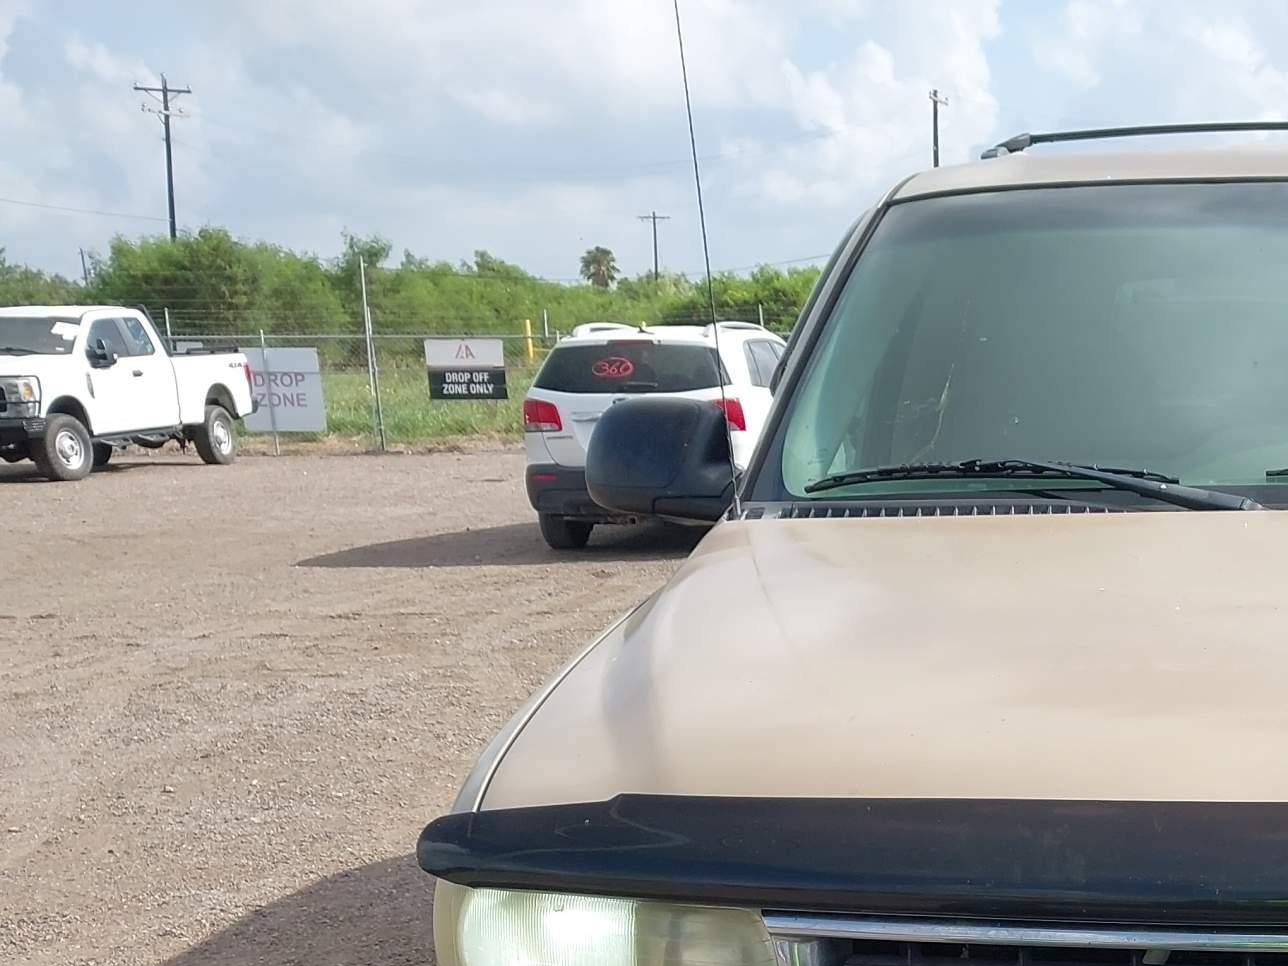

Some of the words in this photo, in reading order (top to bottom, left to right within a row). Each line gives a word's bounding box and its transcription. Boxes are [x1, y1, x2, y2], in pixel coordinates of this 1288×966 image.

[253, 372, 305, 388] DROP
[445, 372, 471, 383] DROP
[472, 372, 489, 383] OFF
[442, 383, 468, 394] ZONE
[469, 383, 494, 394] ONLY
[256, 392, 307, 408] ZONE
